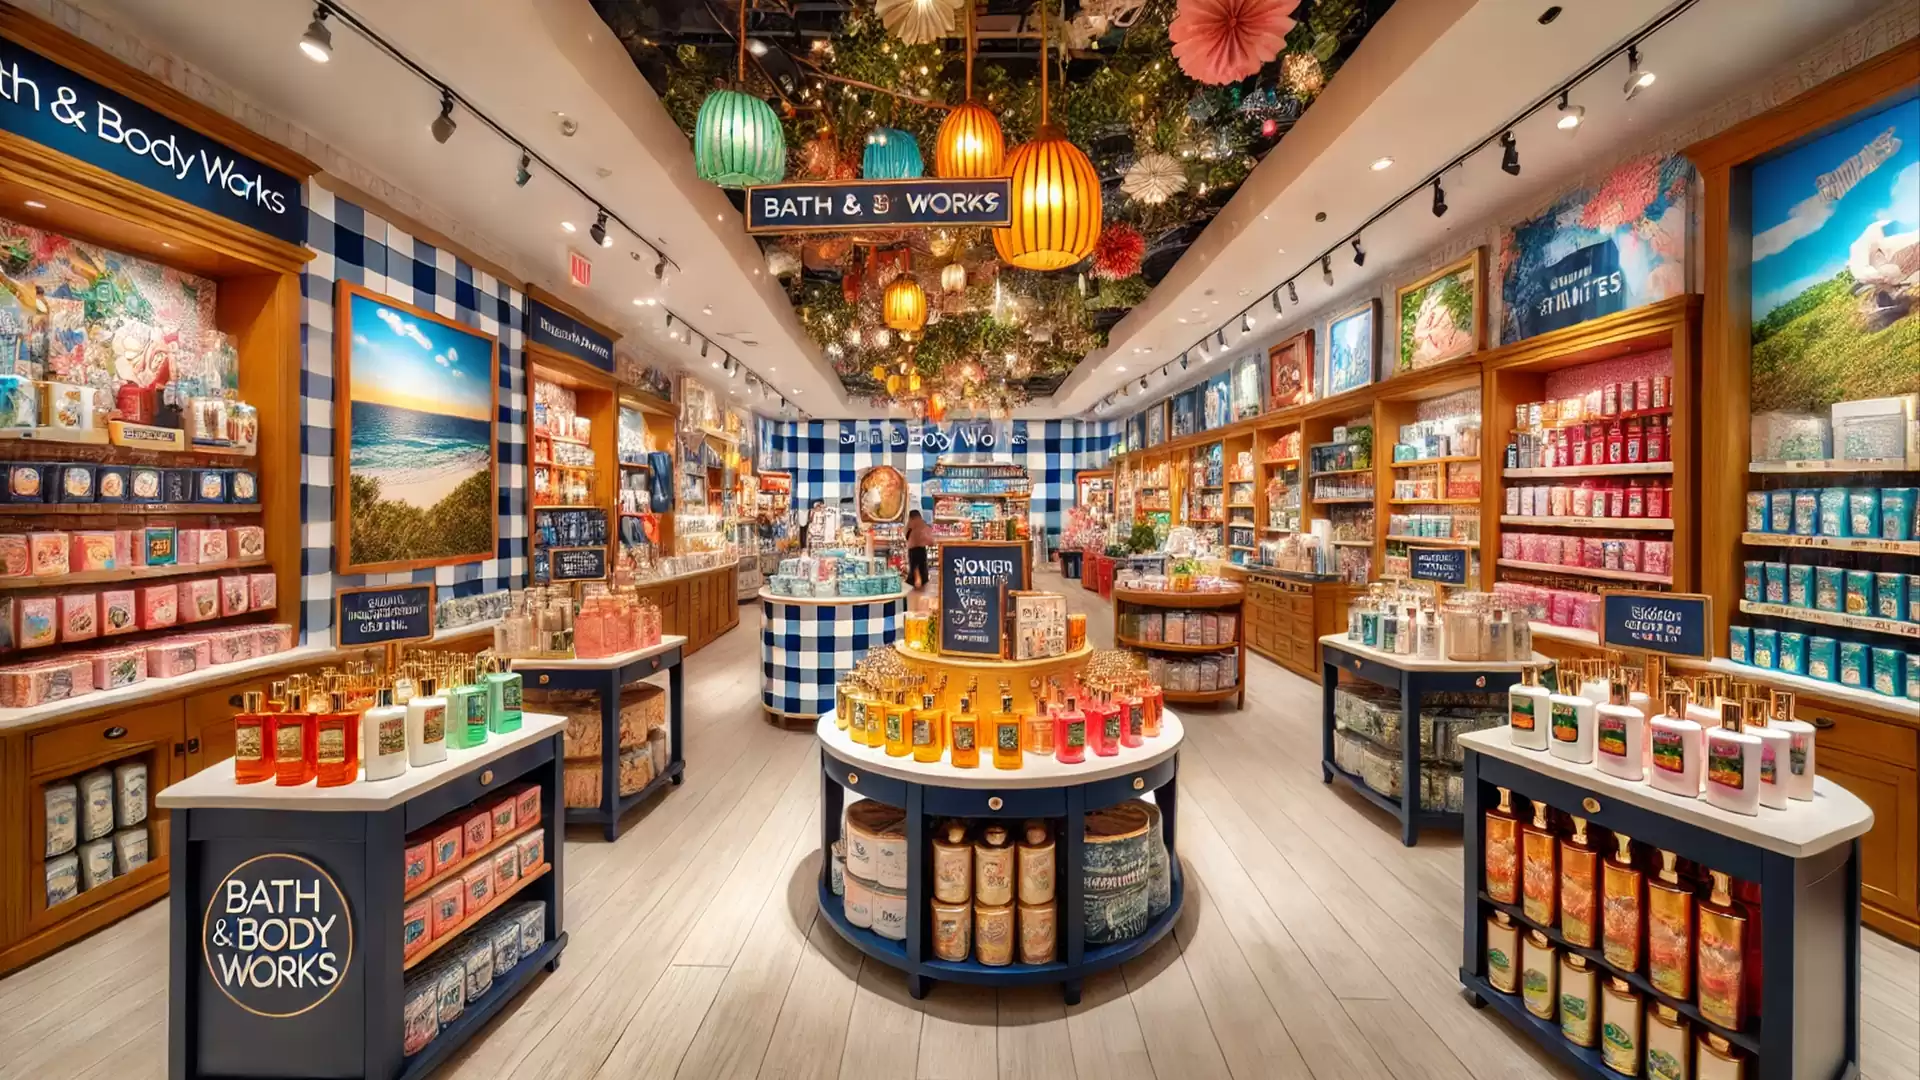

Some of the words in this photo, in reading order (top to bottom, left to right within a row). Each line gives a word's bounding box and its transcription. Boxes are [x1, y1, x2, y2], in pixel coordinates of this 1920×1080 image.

[50, 86, 87, 133] &
[97, 101, 195, 180] Body
[764, 196, 832, 218] BATH
[842, 193, 864, 216] &
[906, 192, 1001, 215] WORKS
[225, 879, 320, 914] BATH
[212, 918, 236, 947] &
[237, 914, 337, 952] BODY
[217, 952, 339, 989] WORKS
